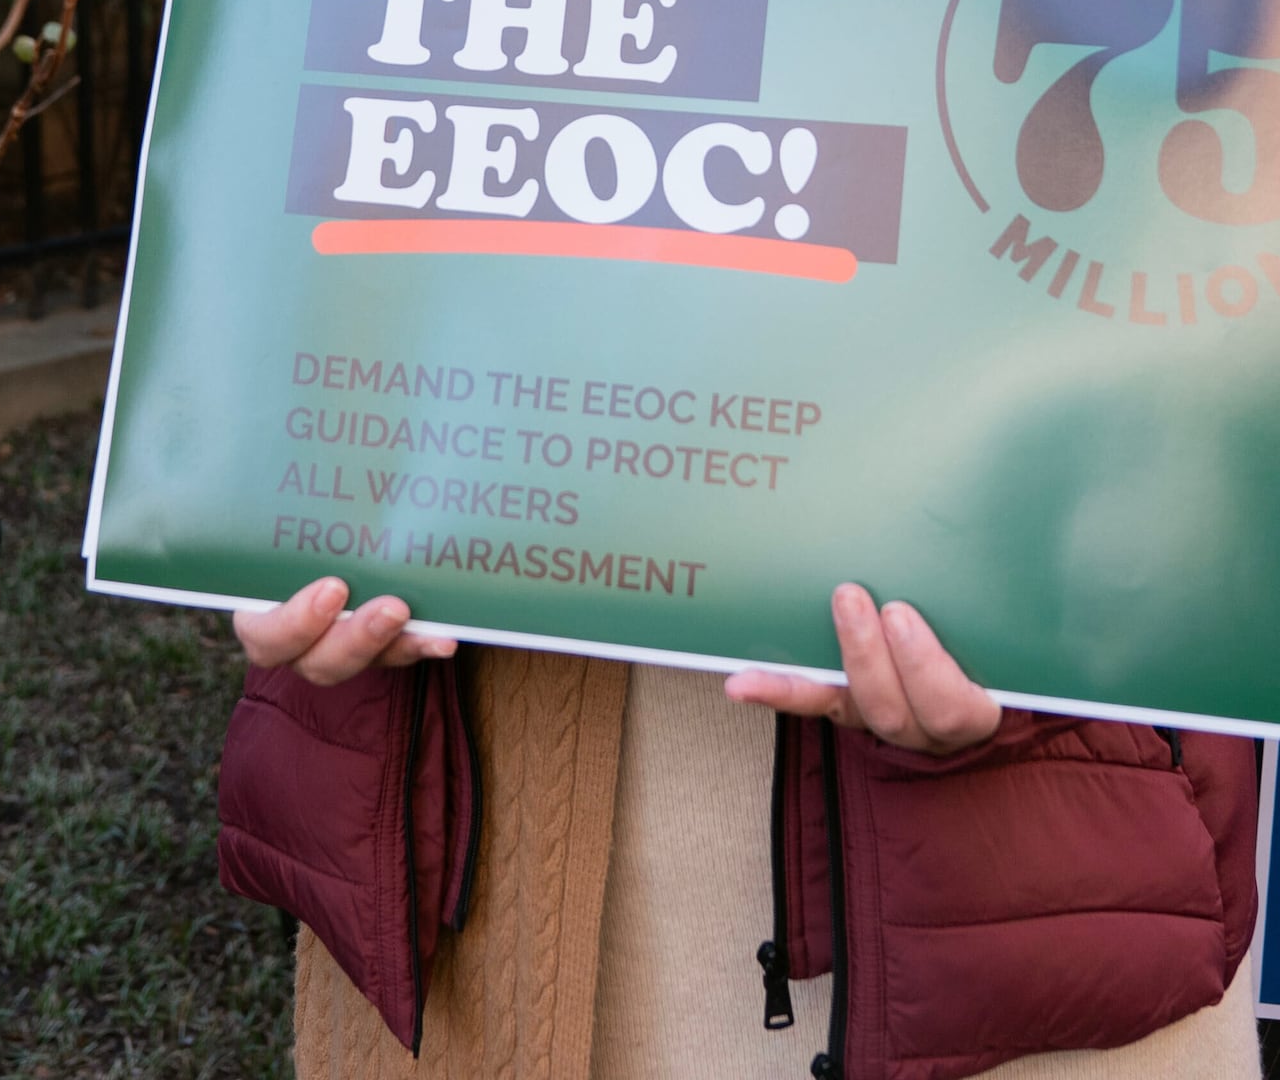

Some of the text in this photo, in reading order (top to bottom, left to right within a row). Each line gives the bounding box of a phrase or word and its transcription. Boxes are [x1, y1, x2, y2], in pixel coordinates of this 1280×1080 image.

[333, 95, 818, 240] EEOC!
[291, 352, 822, 437] DEMAND THE EEOC KEEP
[285, 407, 789, 491] GUIDANCE TO PROTECT
[277, 461, 580, 527] ALL WORKERS
[271, 514, 707, 598] FROM HARASSMENT
